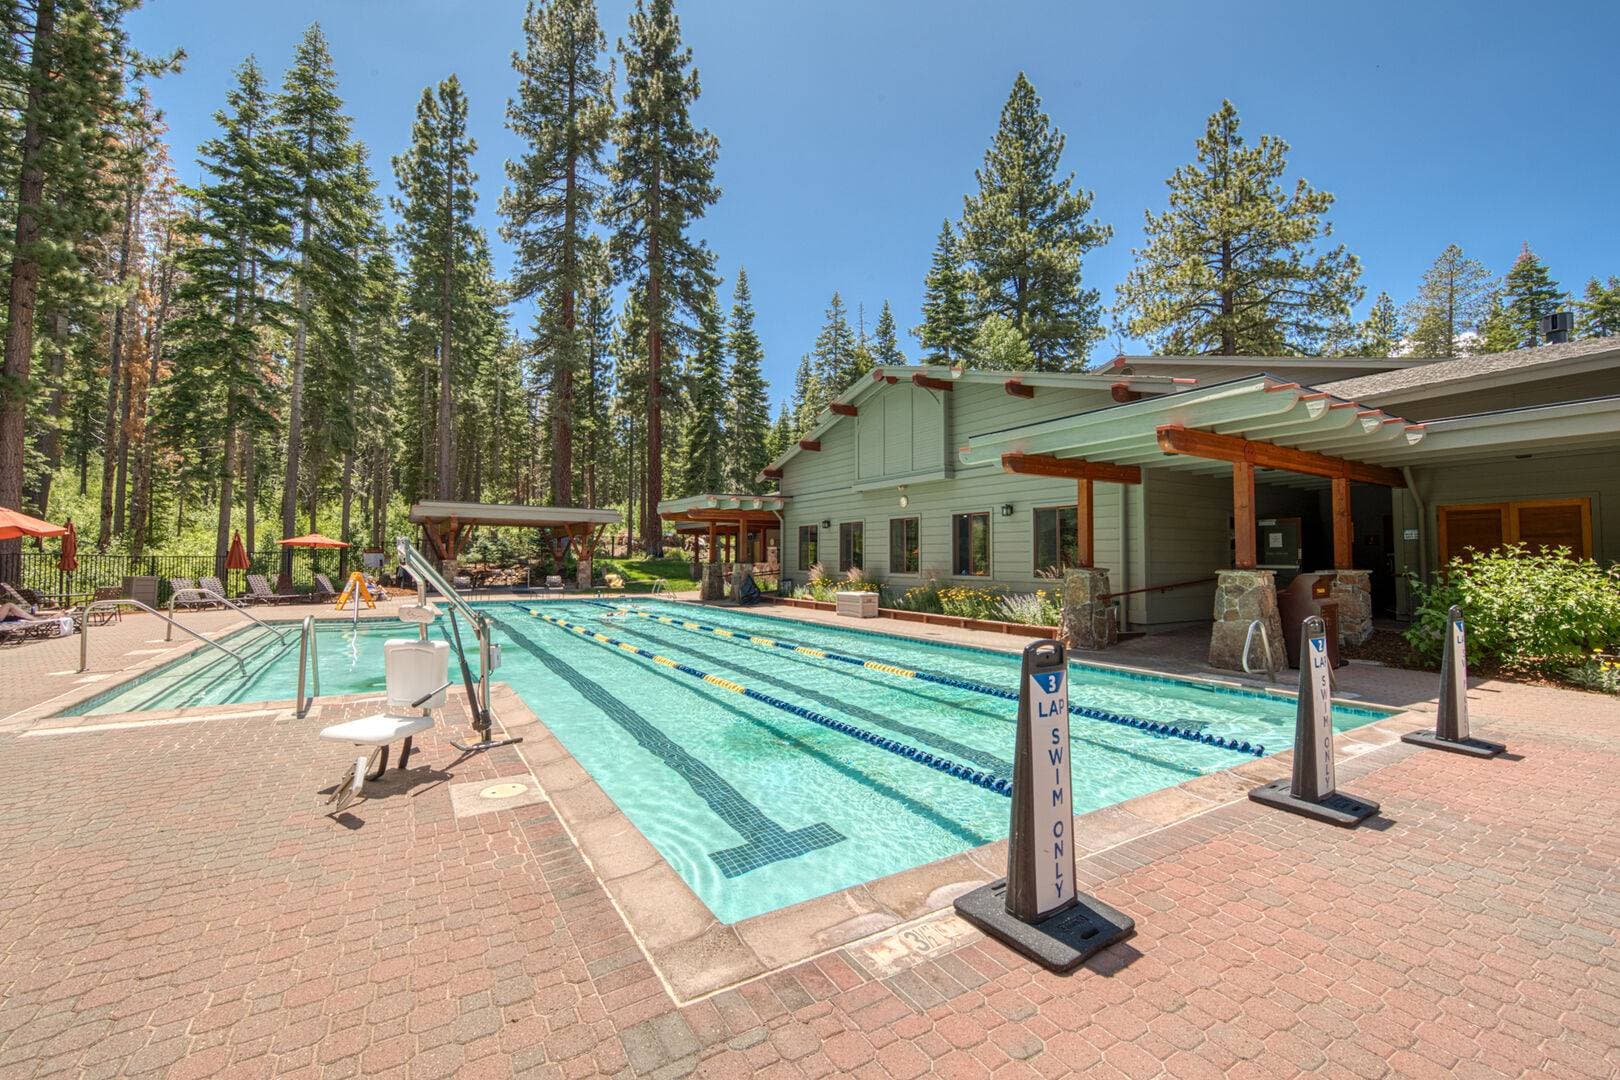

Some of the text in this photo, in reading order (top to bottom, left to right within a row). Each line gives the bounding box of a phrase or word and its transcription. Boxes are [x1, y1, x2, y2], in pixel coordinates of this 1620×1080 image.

[1318, 640, 1323, 651] 2
[1048, 674, 1057, 692] 3
[1038, 699, 1065, 718] LAP
[1048, 728, 1063, 807] SWIM
[1052, 820, 1065, 898] ONLY
